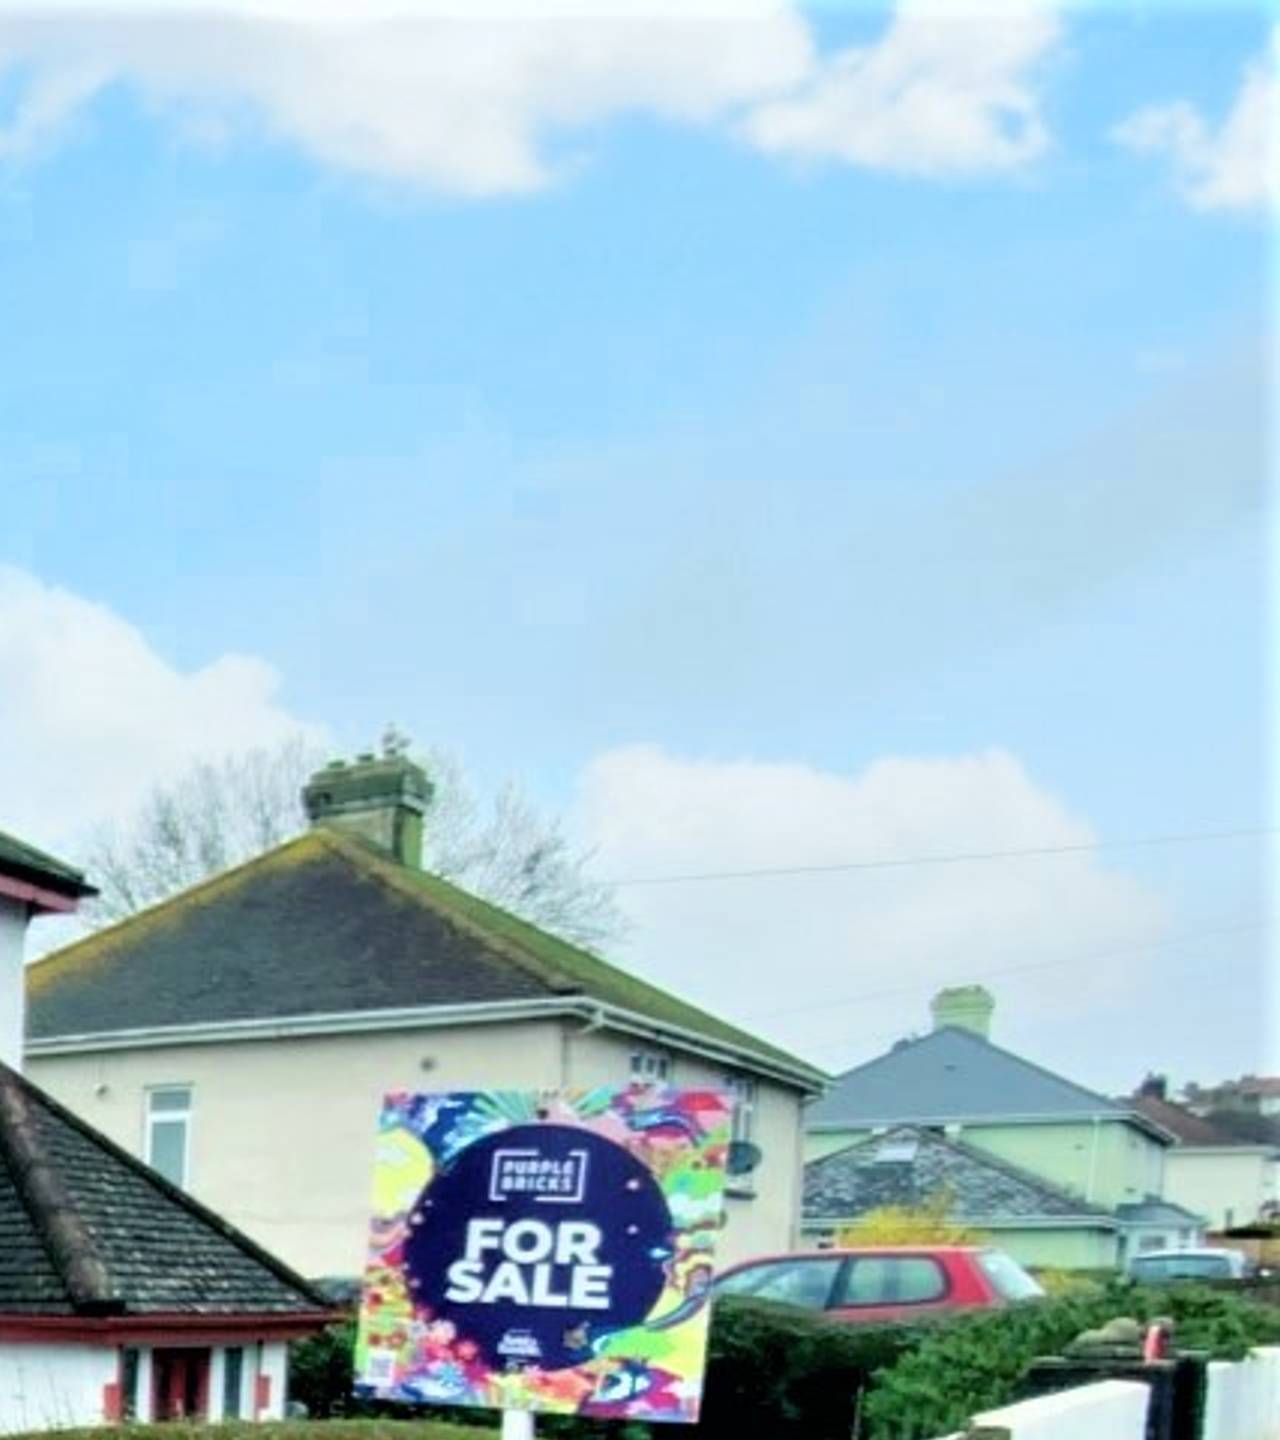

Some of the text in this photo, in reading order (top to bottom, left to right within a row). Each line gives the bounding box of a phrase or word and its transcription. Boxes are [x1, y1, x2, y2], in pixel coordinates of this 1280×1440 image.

[502, 1160, 575, 1175] PURPLE
[500, 1176, 572, 1192] BRICKS
[464, 1217, 603, 1266] FOR
[443, 1259, 614, 1310] SALE
